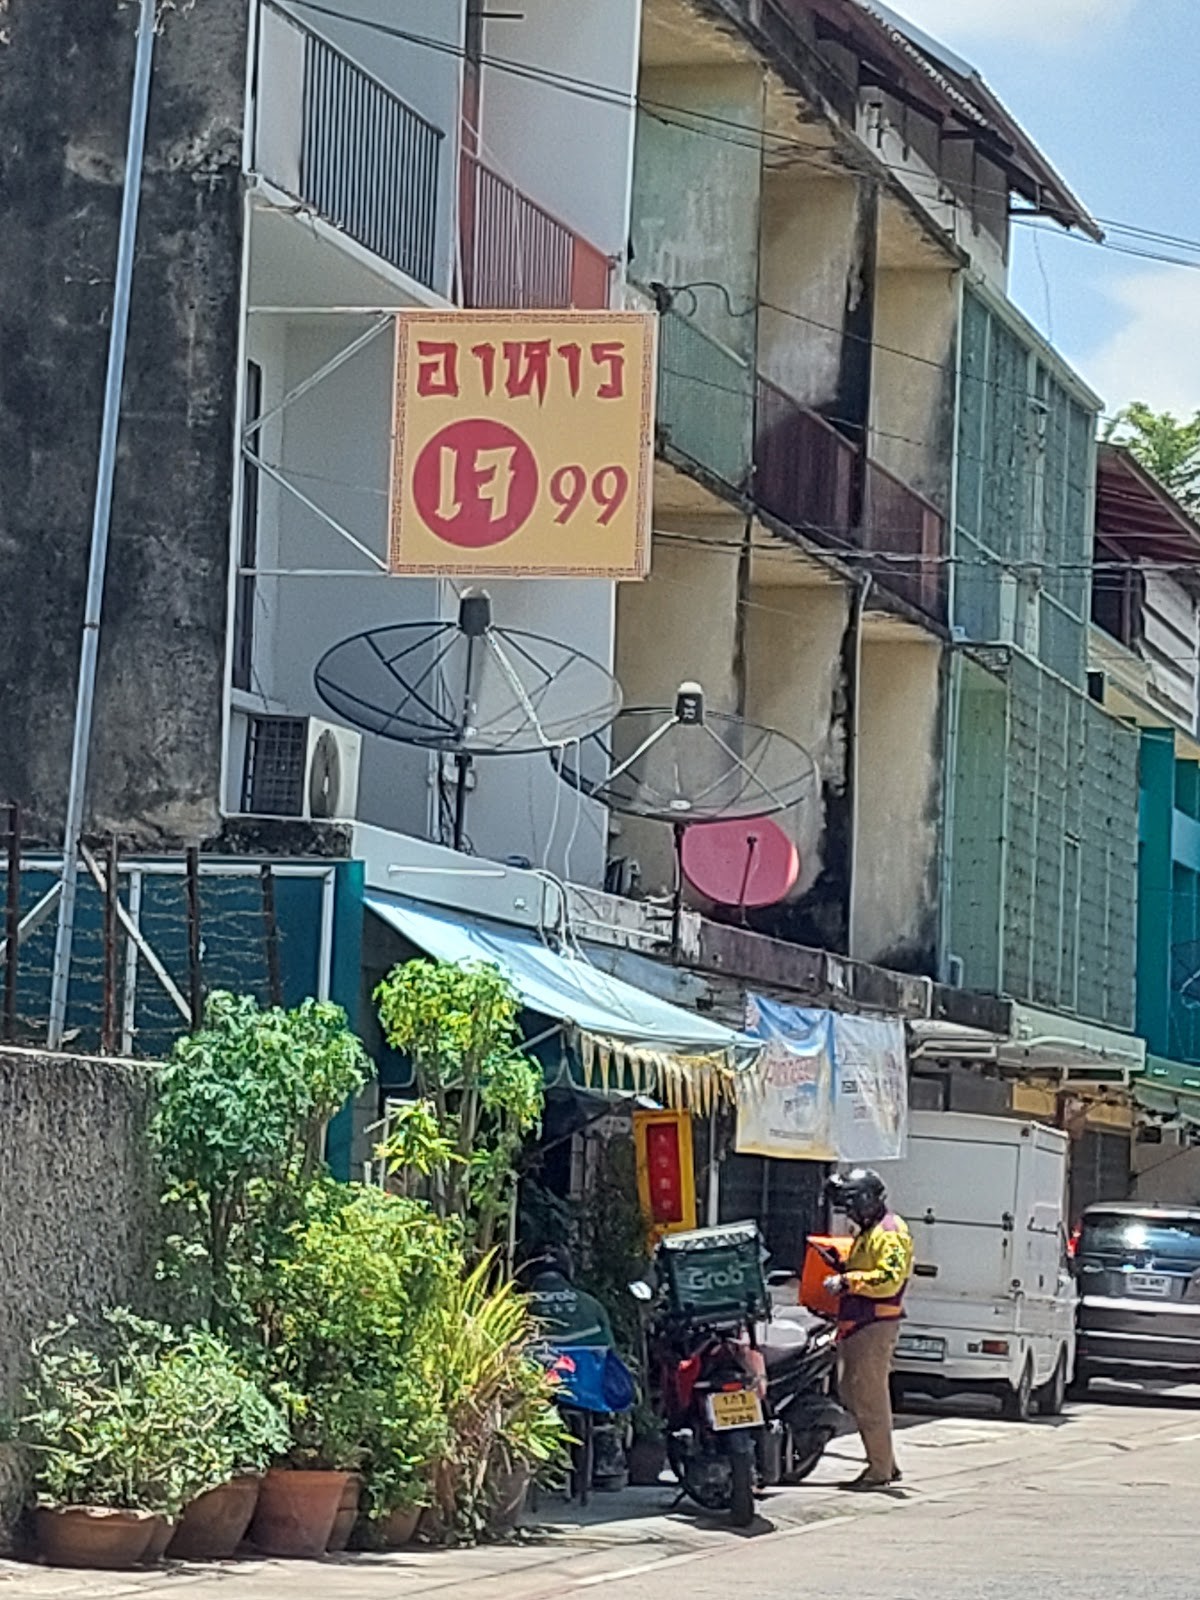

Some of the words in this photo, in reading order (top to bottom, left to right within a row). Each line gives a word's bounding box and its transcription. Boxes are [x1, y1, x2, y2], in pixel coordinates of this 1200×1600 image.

[416, 339, 626, 409] อาหาร
[434, 446, 517, 522] เจ
[550, 465, 629, 526] 99
